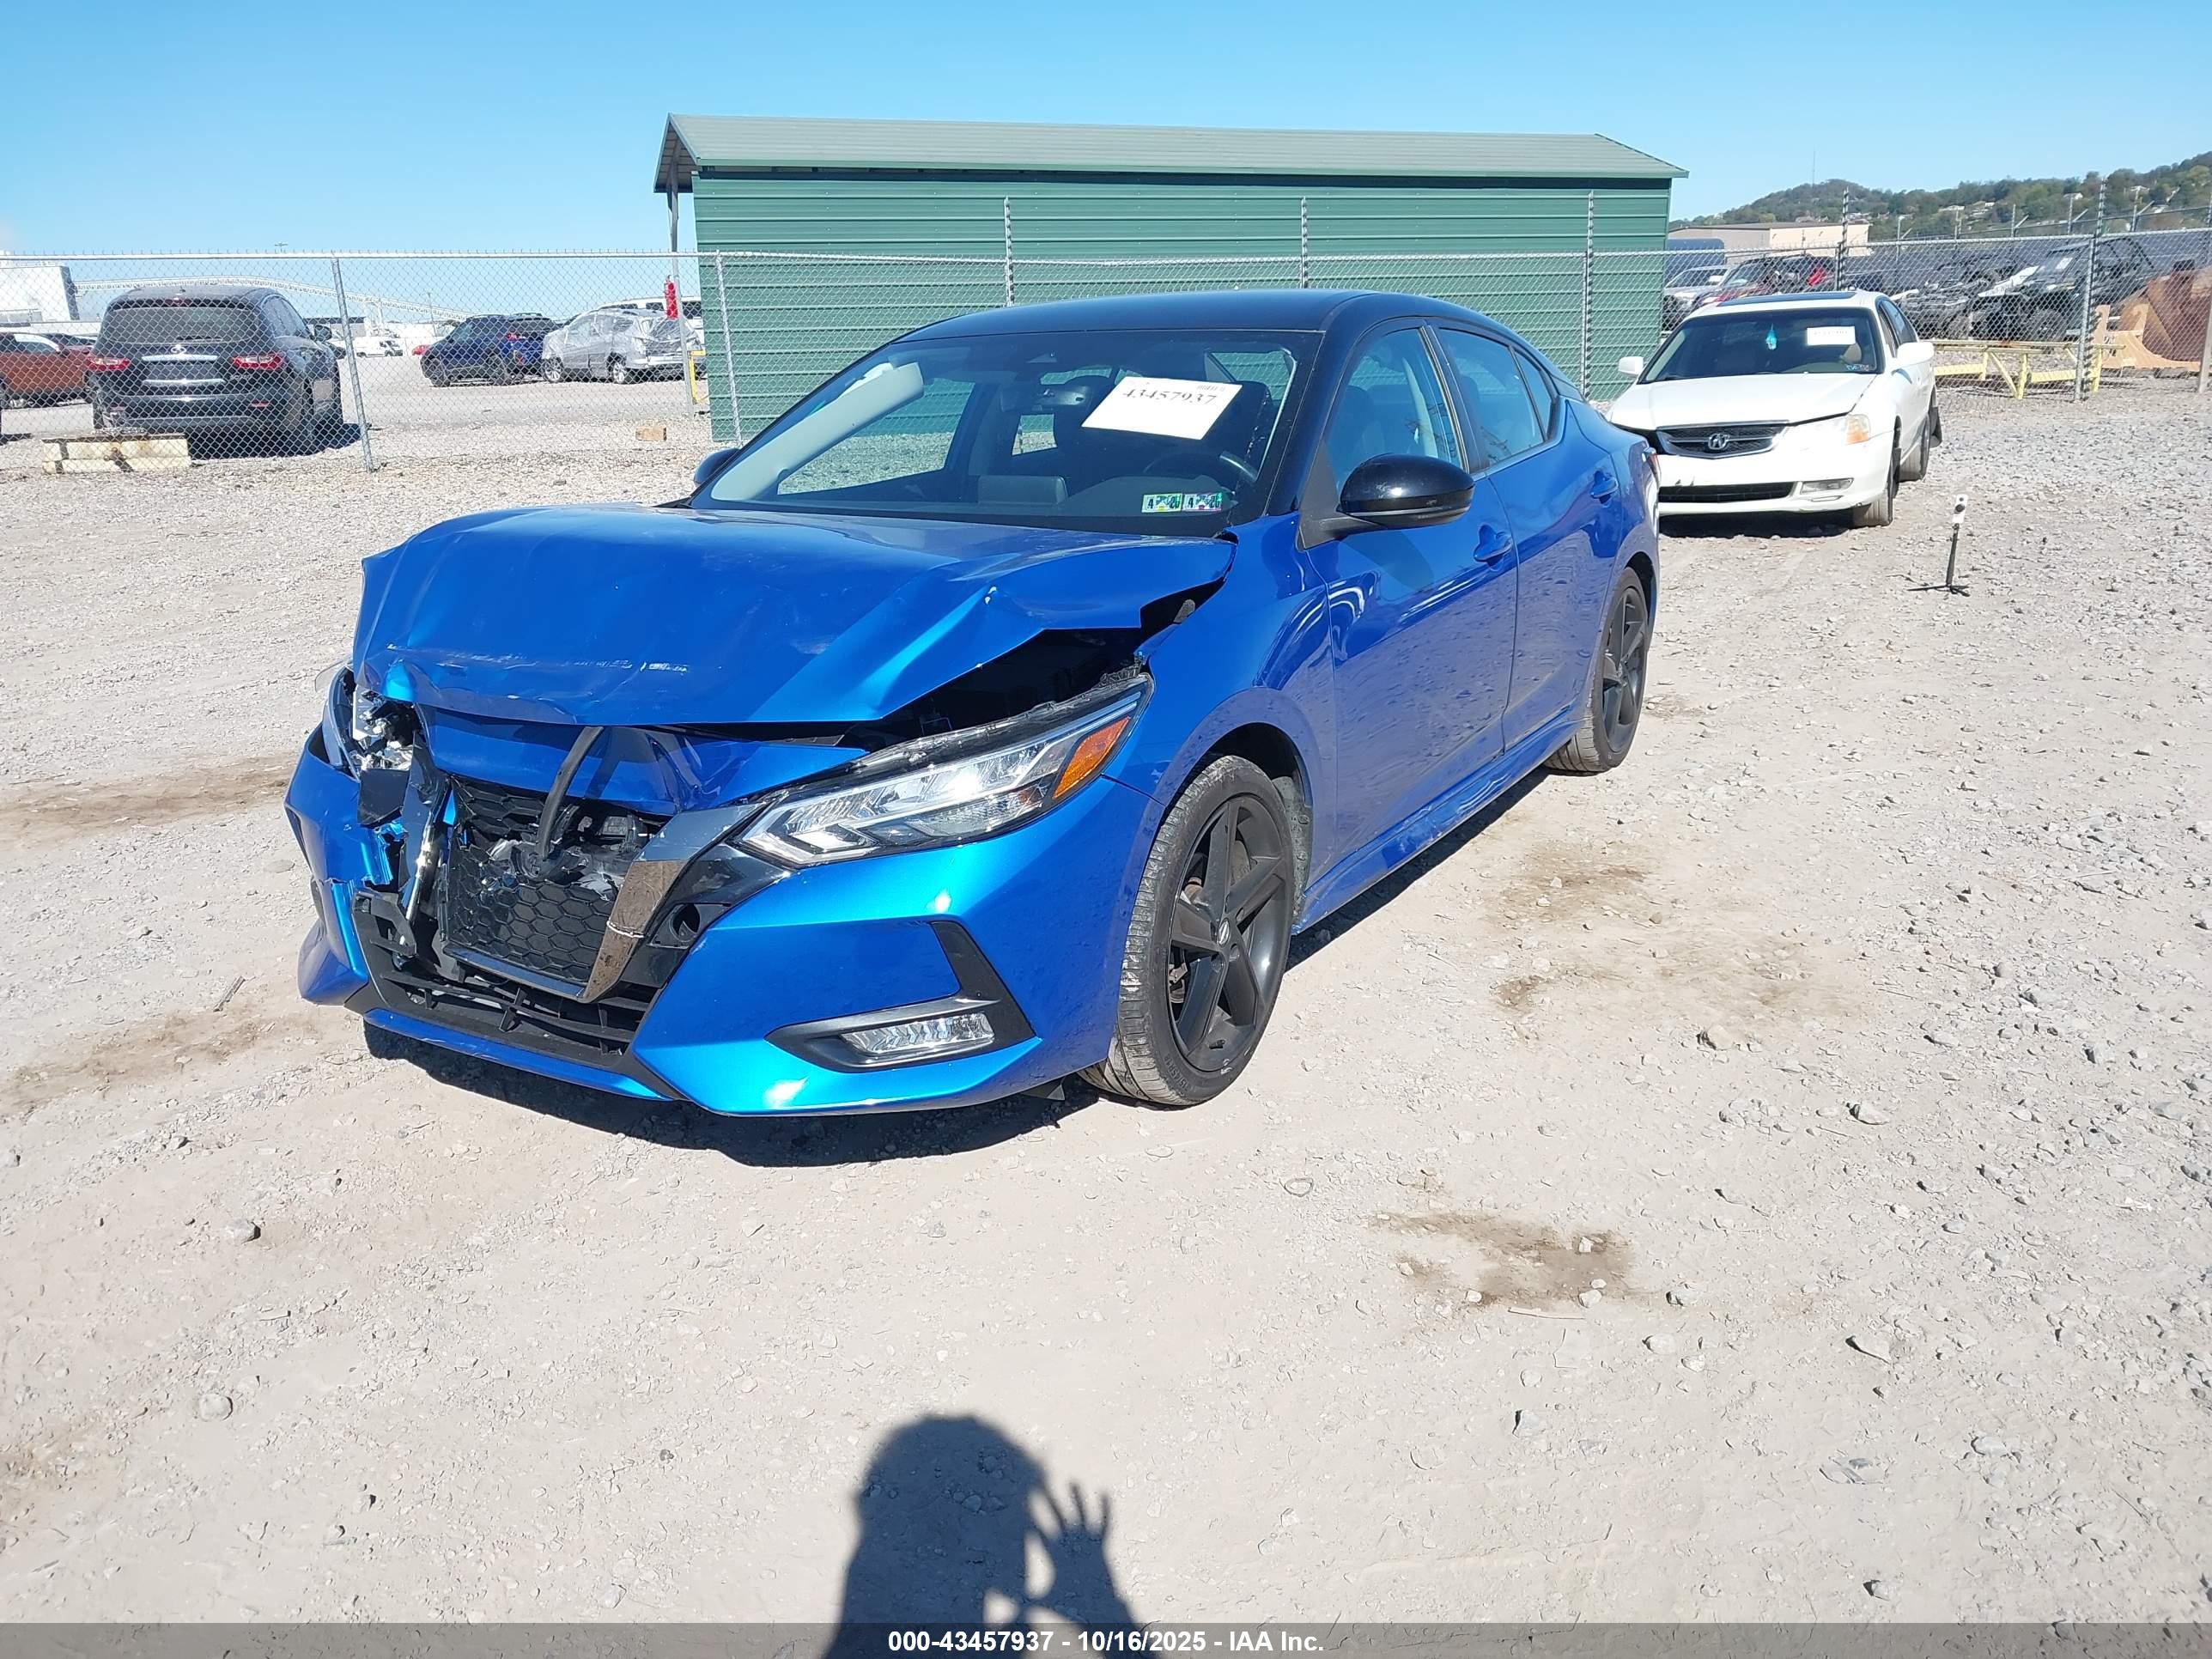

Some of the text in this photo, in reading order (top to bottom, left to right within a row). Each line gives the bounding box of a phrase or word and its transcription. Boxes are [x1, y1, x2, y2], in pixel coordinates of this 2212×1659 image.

[1123, 389, 1217, 404] 43457937
[1148, 498, 1154, 509] 4
[1188, 497, 1194, 508] 4
